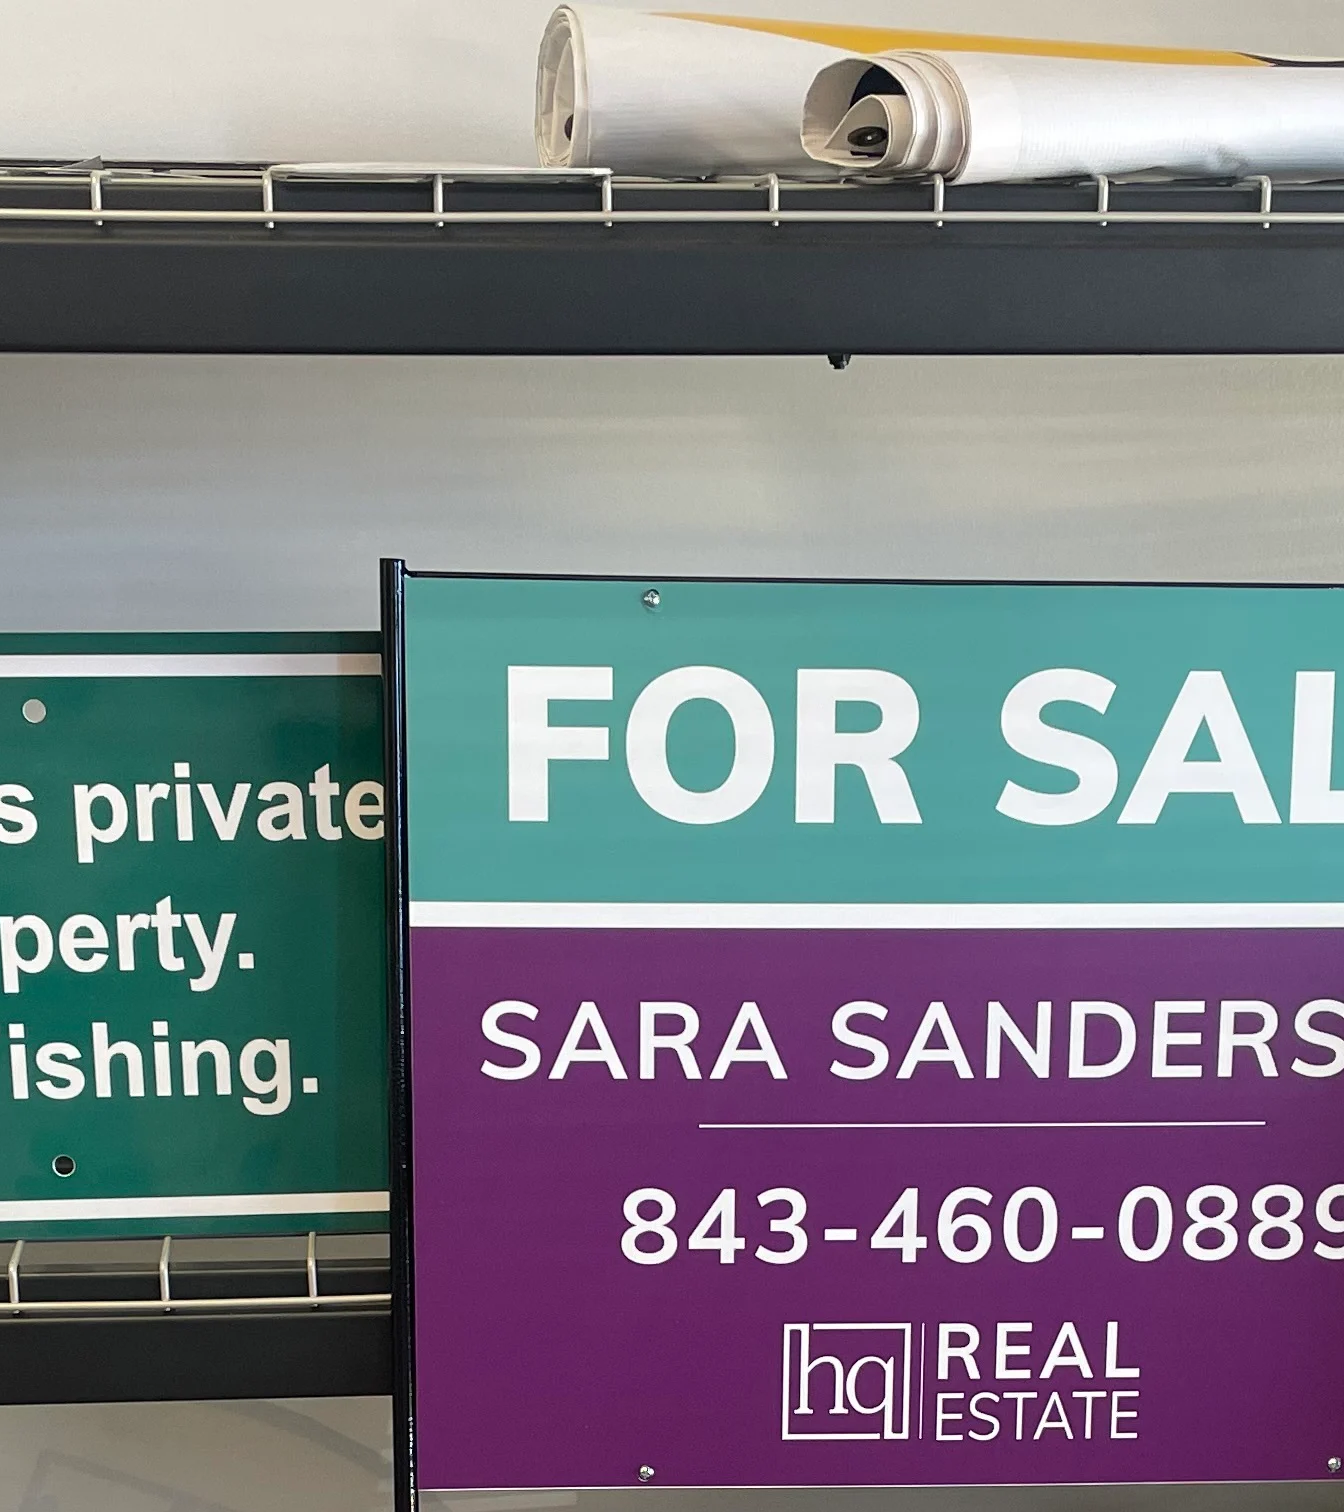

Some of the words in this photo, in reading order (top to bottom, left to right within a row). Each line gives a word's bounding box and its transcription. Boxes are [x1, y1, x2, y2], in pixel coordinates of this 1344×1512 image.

[508, 666, 922, 824] FOR
[74, 763, 384, 863] private
[481, 1001, 787, 1080] SARA
[938, 1322, 1139, 1379] REAL
[936, 1391, 1139, 1440] ESTATE
